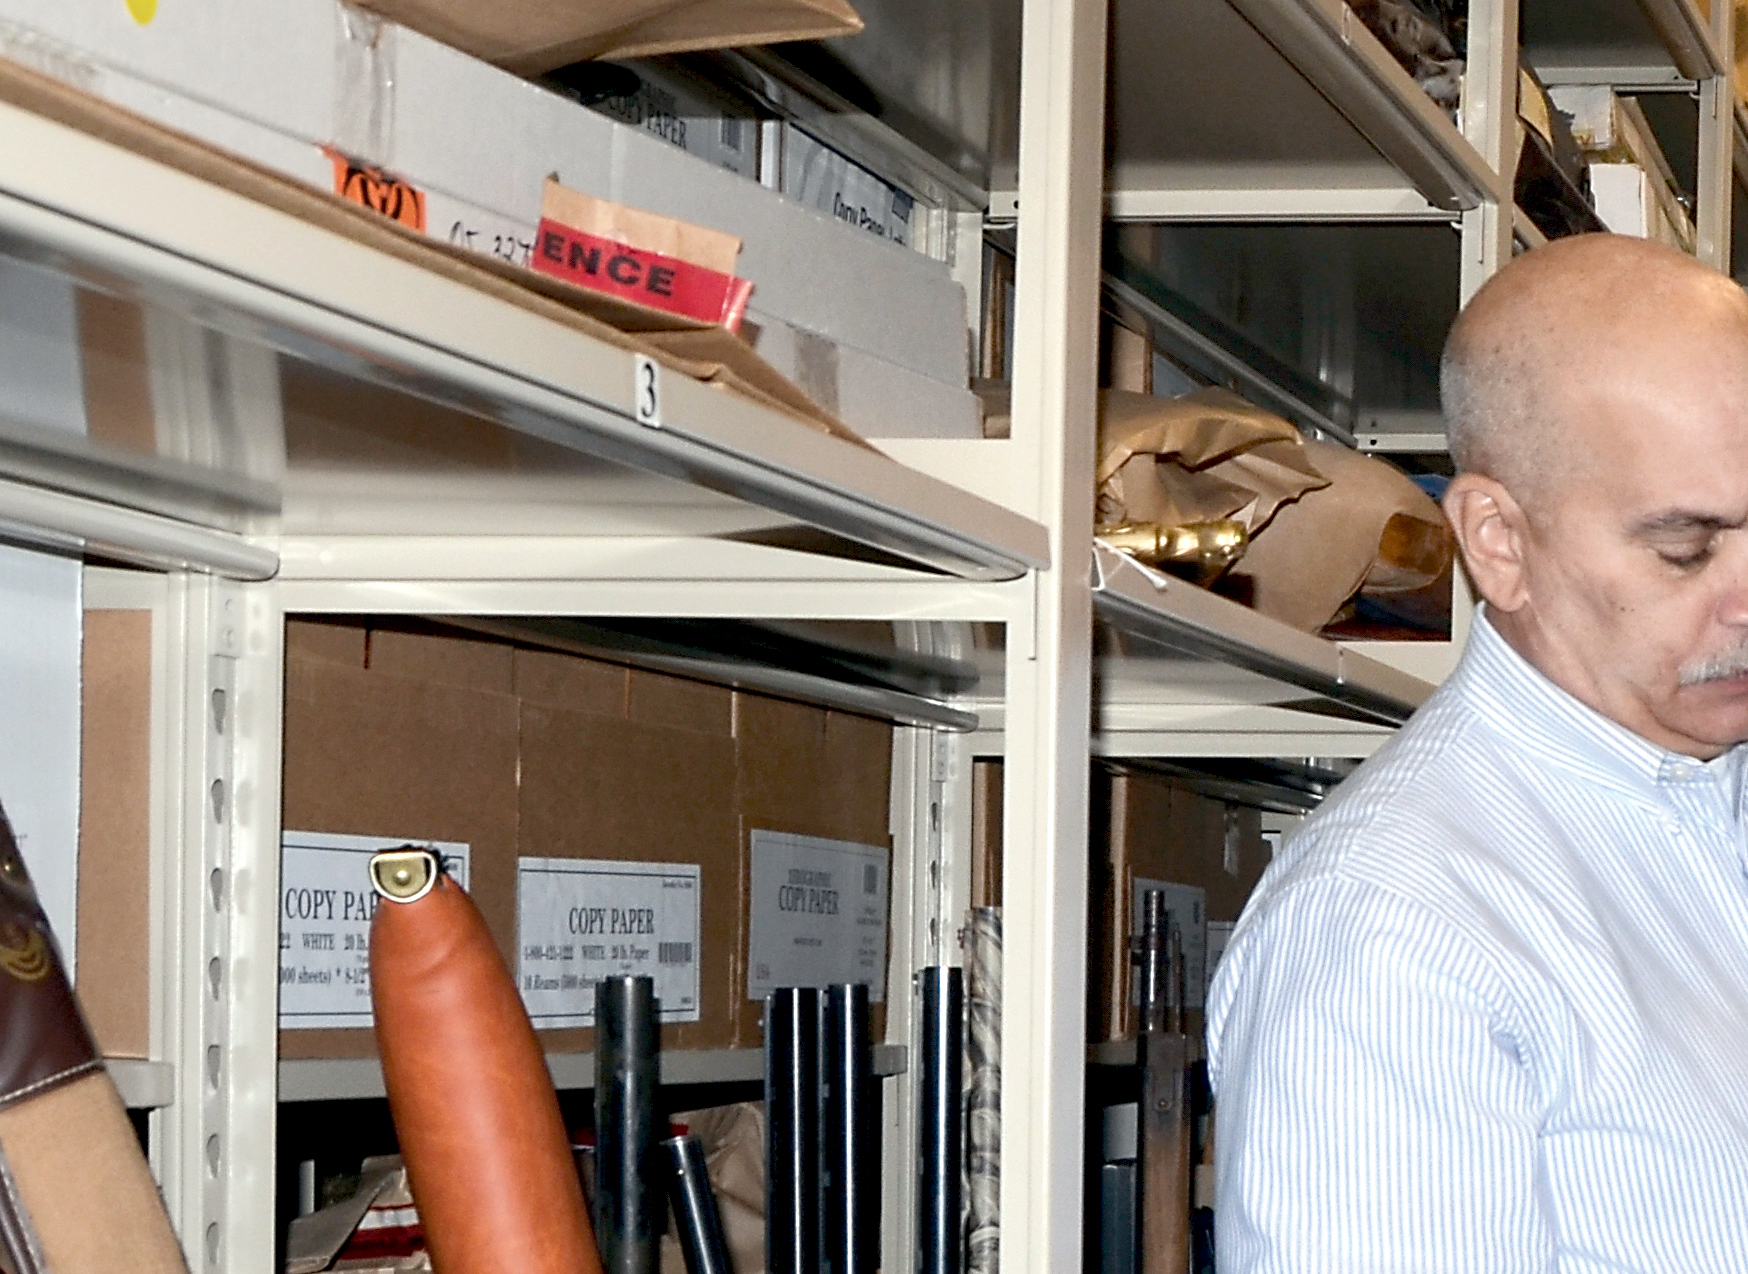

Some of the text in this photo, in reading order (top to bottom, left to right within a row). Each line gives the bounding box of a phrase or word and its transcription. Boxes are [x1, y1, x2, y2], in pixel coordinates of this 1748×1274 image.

[645, 99, 688, 151] PAPER
[638, 363, 659, 418] 3
[284, 888, 381, 921] COPY PAP
[778, 885, 839, 915] COPY PAPER
[569, 907, 654, 934] COPY PAPER
[302, 933, 335, 950] WHITE
